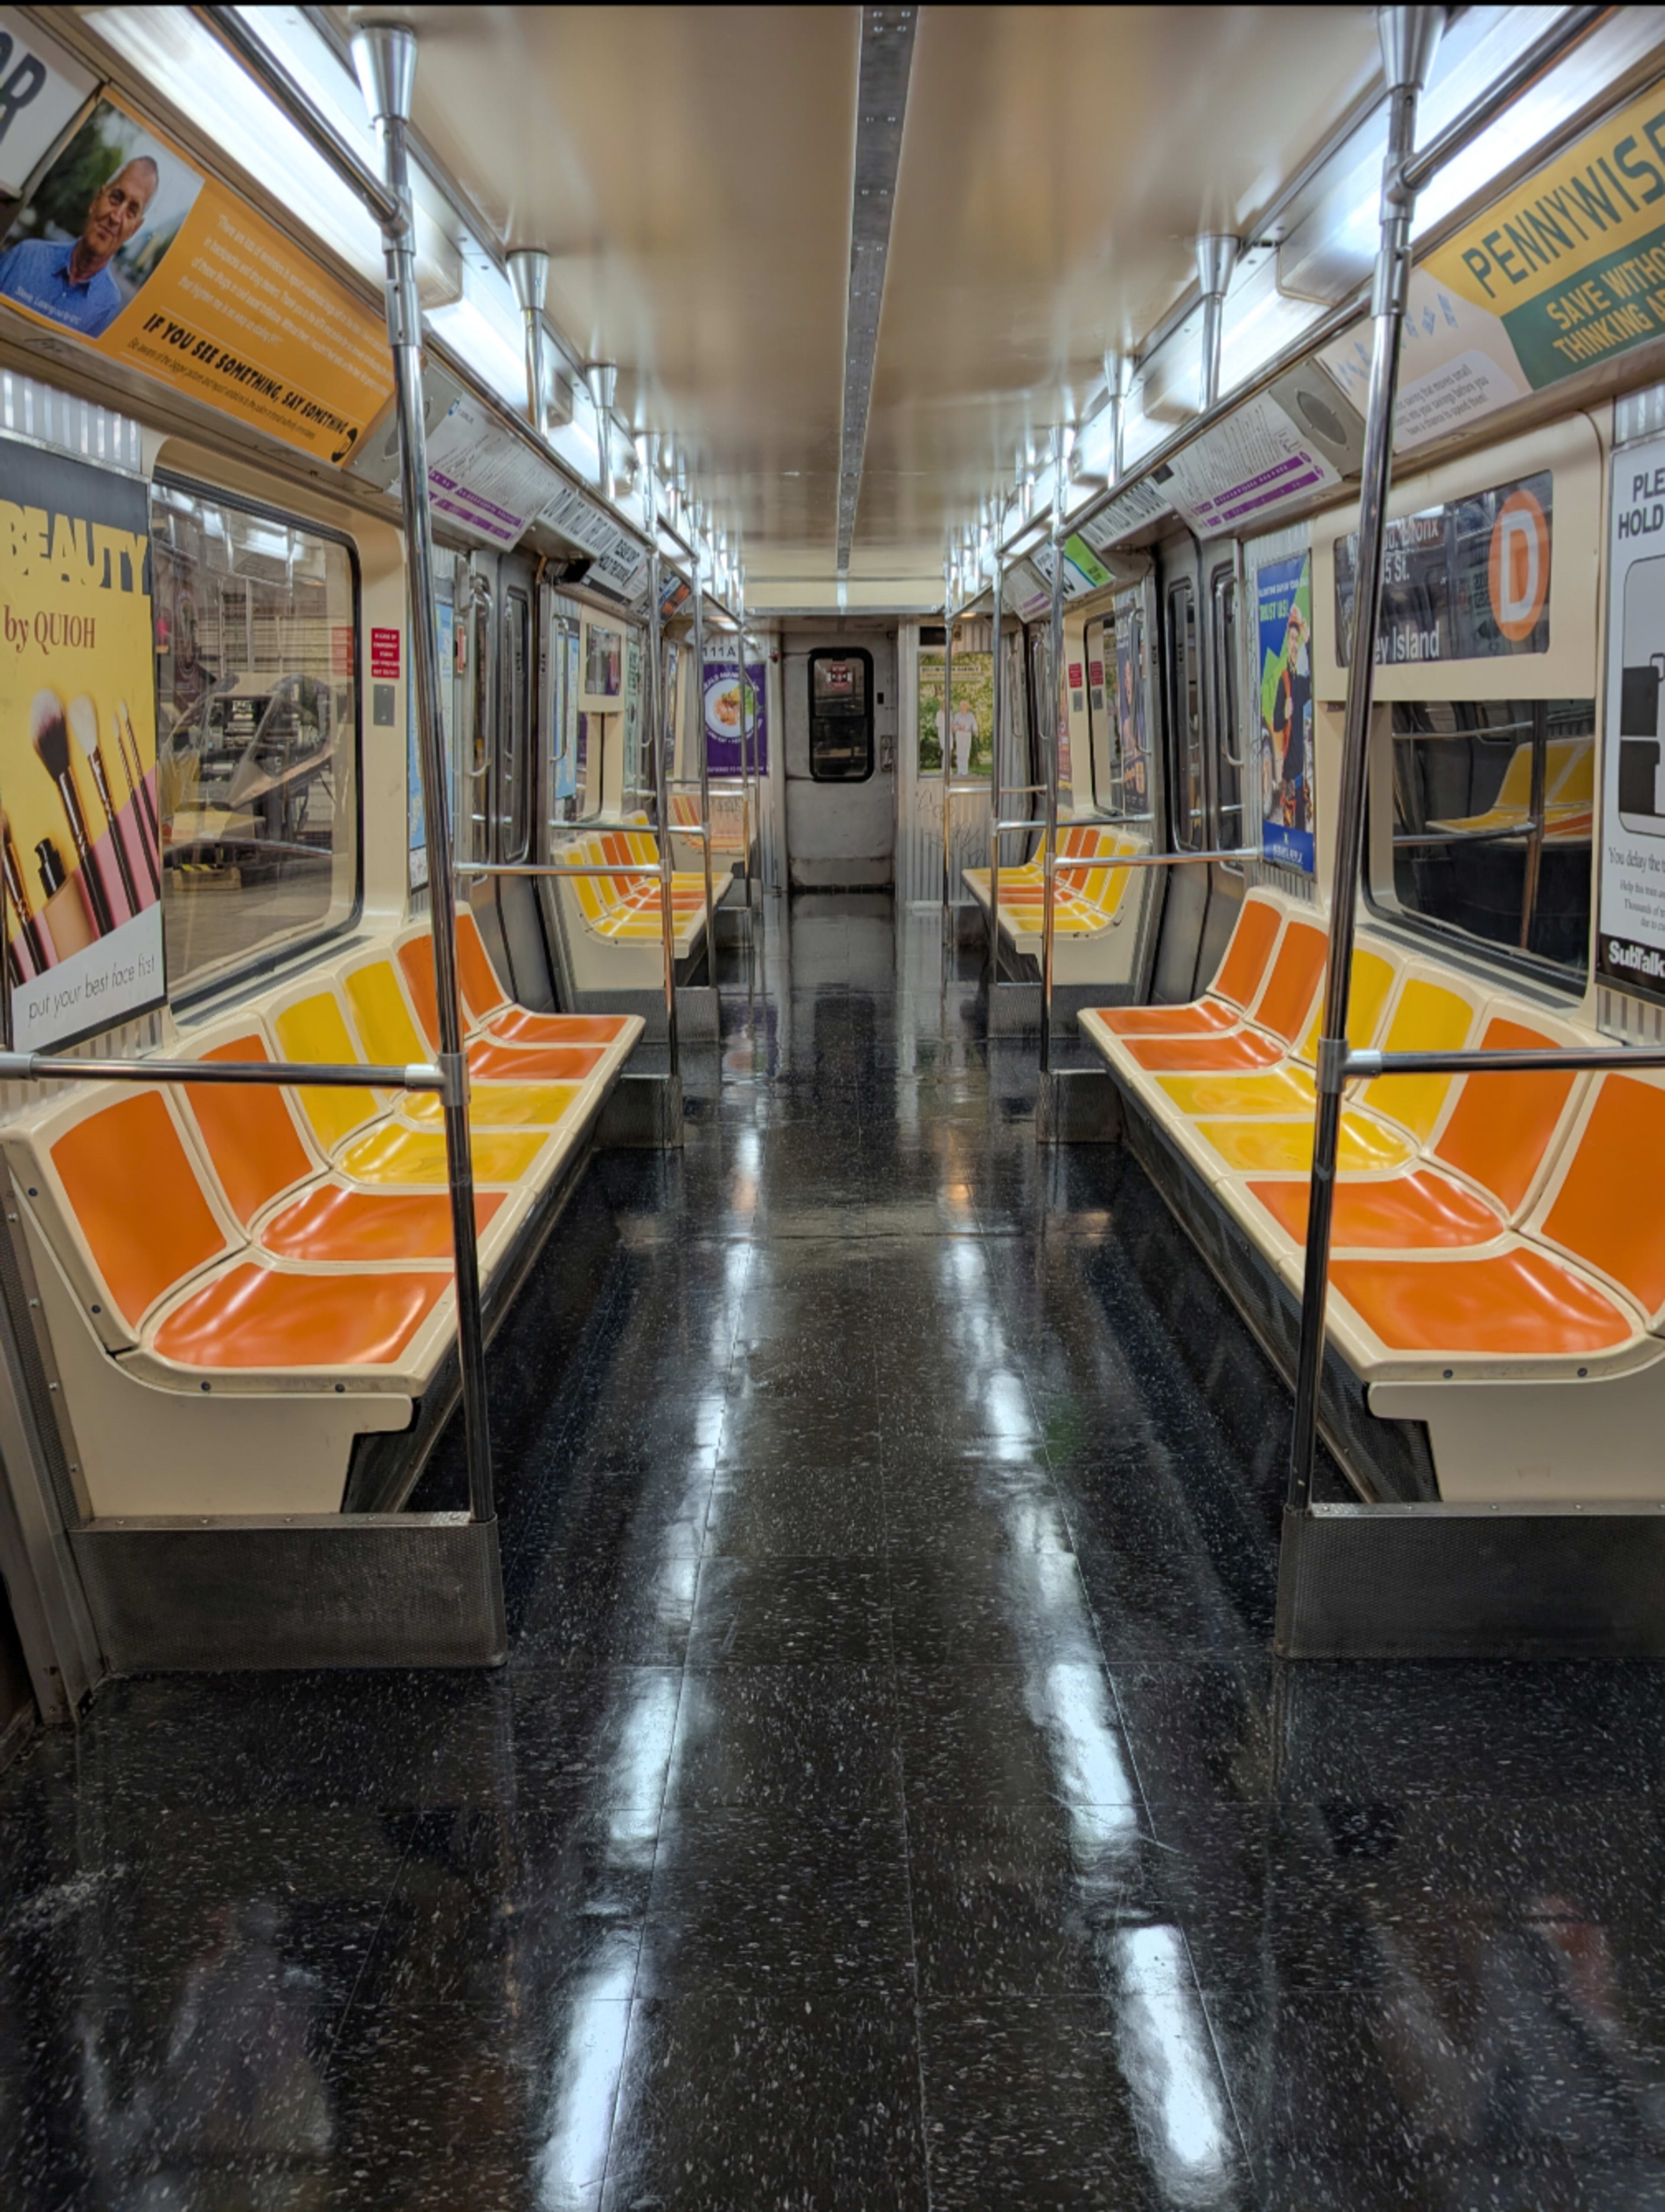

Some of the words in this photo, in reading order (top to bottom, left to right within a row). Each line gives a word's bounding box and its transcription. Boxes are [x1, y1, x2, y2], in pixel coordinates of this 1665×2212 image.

[1546, 280, 1611, 330] SAVE
[1600, 241, 1665, 300] WITHO
[1552, 303, 1655, 363] THINKING
[142, 313, 166, 333] IF
[161, 322, 196, 350] YOU
[191, 340, 219, 364] SEE
[214, 353, 283, 402] SOMETHING,
[281, 391, 306, 411] SAY
[300, 402, 349, 435] SOMETHING
[0, 499, 148, 594] BEAUTY
[1618, 504, 1664, 540] HOLD
[1501, 510, 1539, 624] D
[4, 604, 29, 653] by
[34, 610, 95, 655] QUIOH
[1393, 620, 1440, 661] Island
[1626, 849, 1647, 873] delay
[1649, 853, 1660, 872] the
[1608, 940, 1665, 977] SubTalk
[28, 993, 50, 1029] put
[54, 983, 82, 1018] your
[85, 969, 108, 999] best
[138, 952, 155, 978] first
